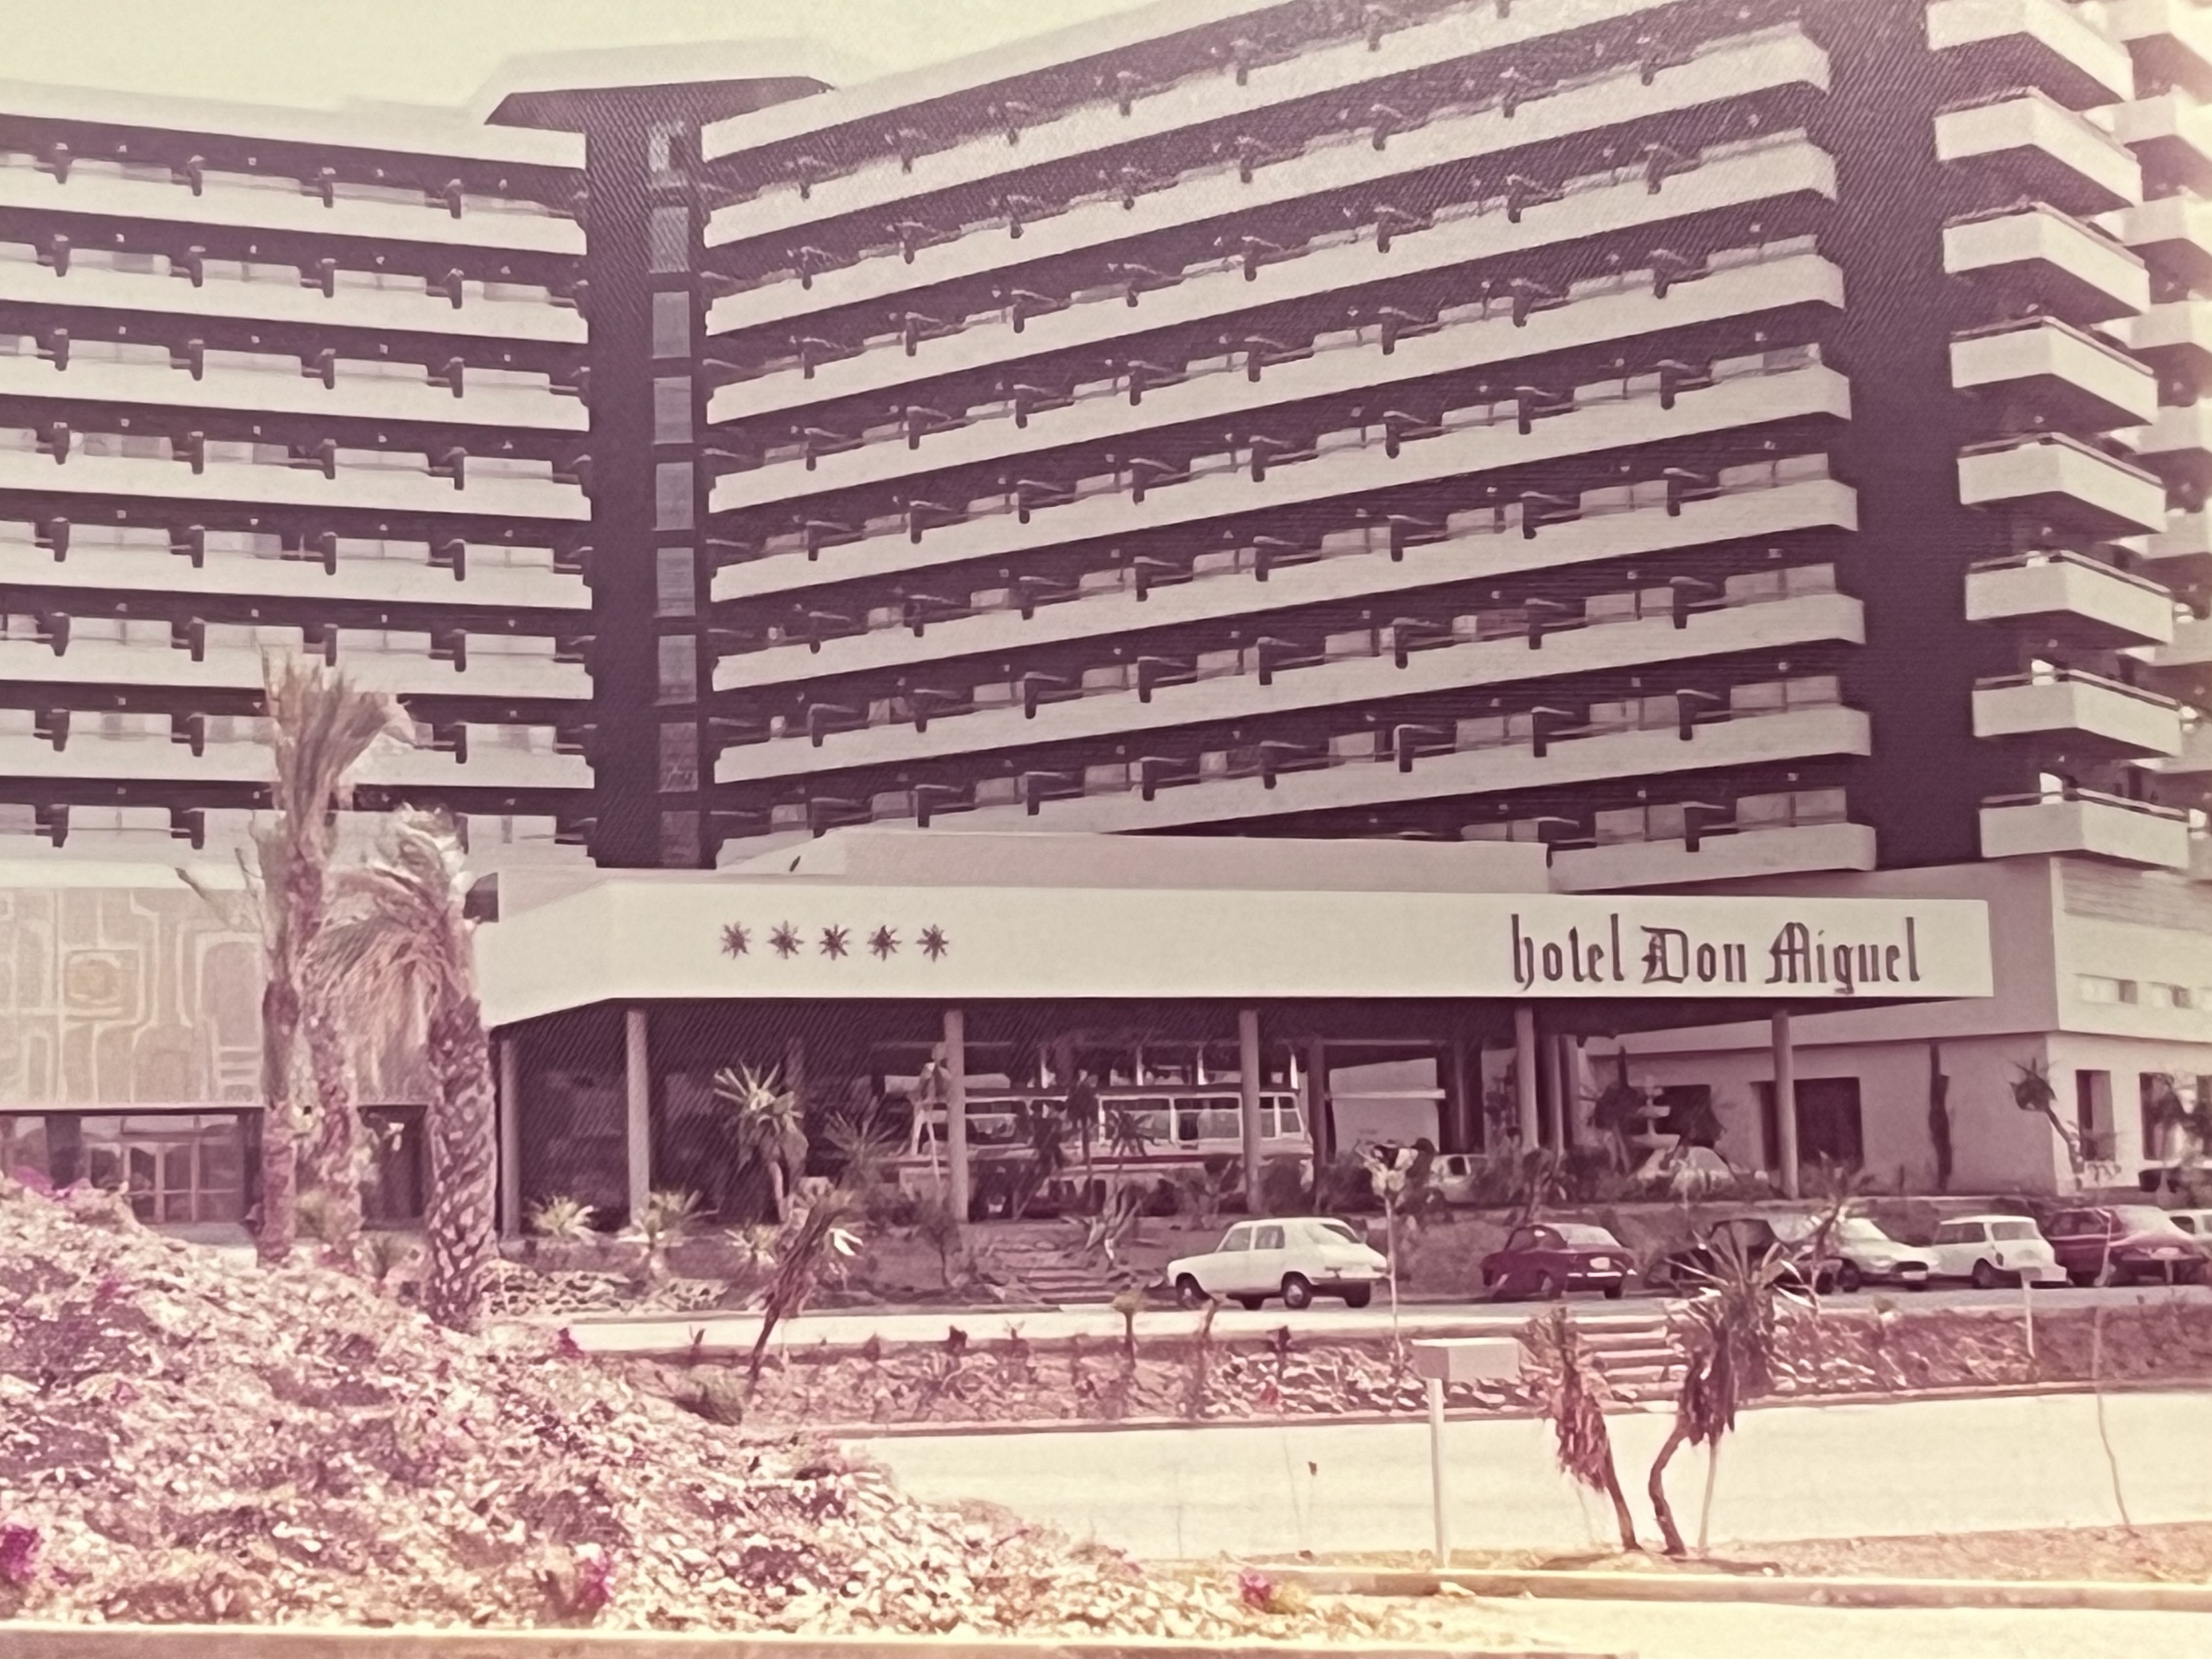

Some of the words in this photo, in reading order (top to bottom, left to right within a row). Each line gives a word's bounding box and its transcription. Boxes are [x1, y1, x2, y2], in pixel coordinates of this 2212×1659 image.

[1511, 913, 1624, 990] hotel
[1640, 925, 1746, 984] Don
[1765, 917, 1920, 994] Miguel
